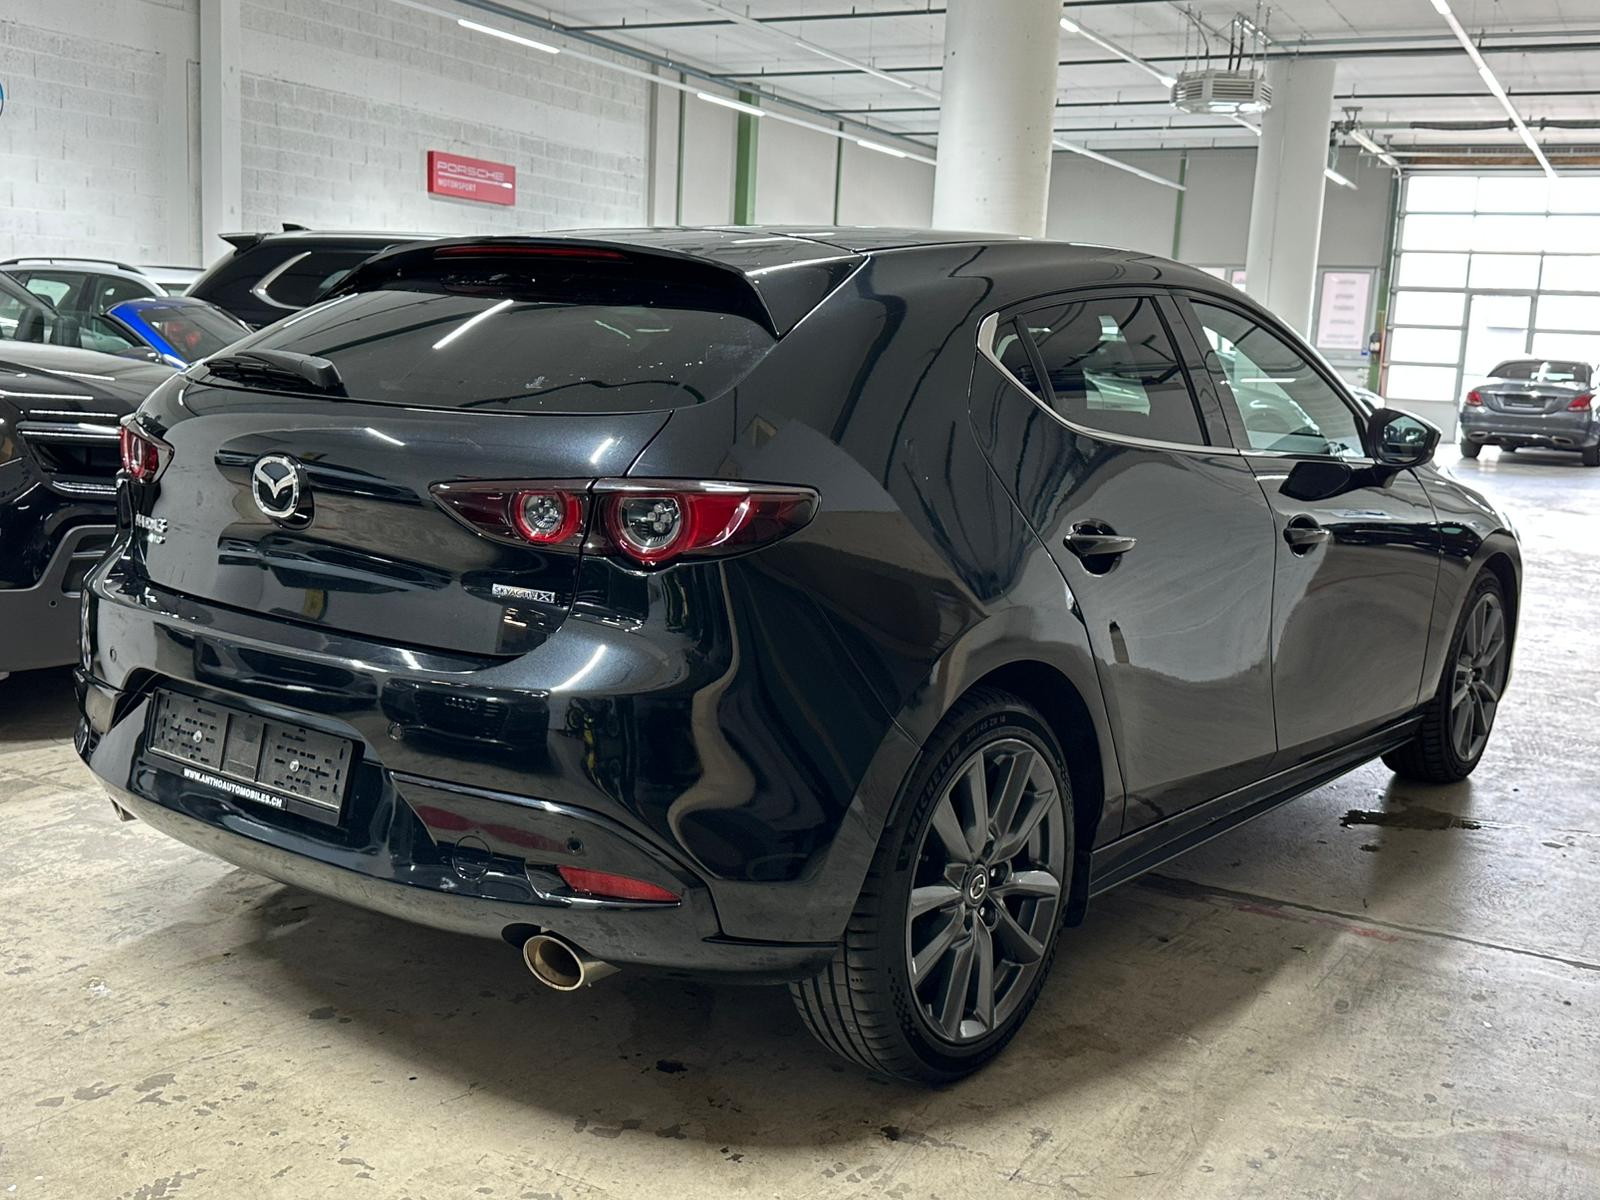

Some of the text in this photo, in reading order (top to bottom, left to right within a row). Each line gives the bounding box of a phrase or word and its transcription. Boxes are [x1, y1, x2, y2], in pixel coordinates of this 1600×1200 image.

[437, 161, 504, 181] PORSCHE
[183, 767, 282, 808] WWW.ANTHOAUTOMOBILES.CH
[908, 743, 962, 841] MICHELIN
